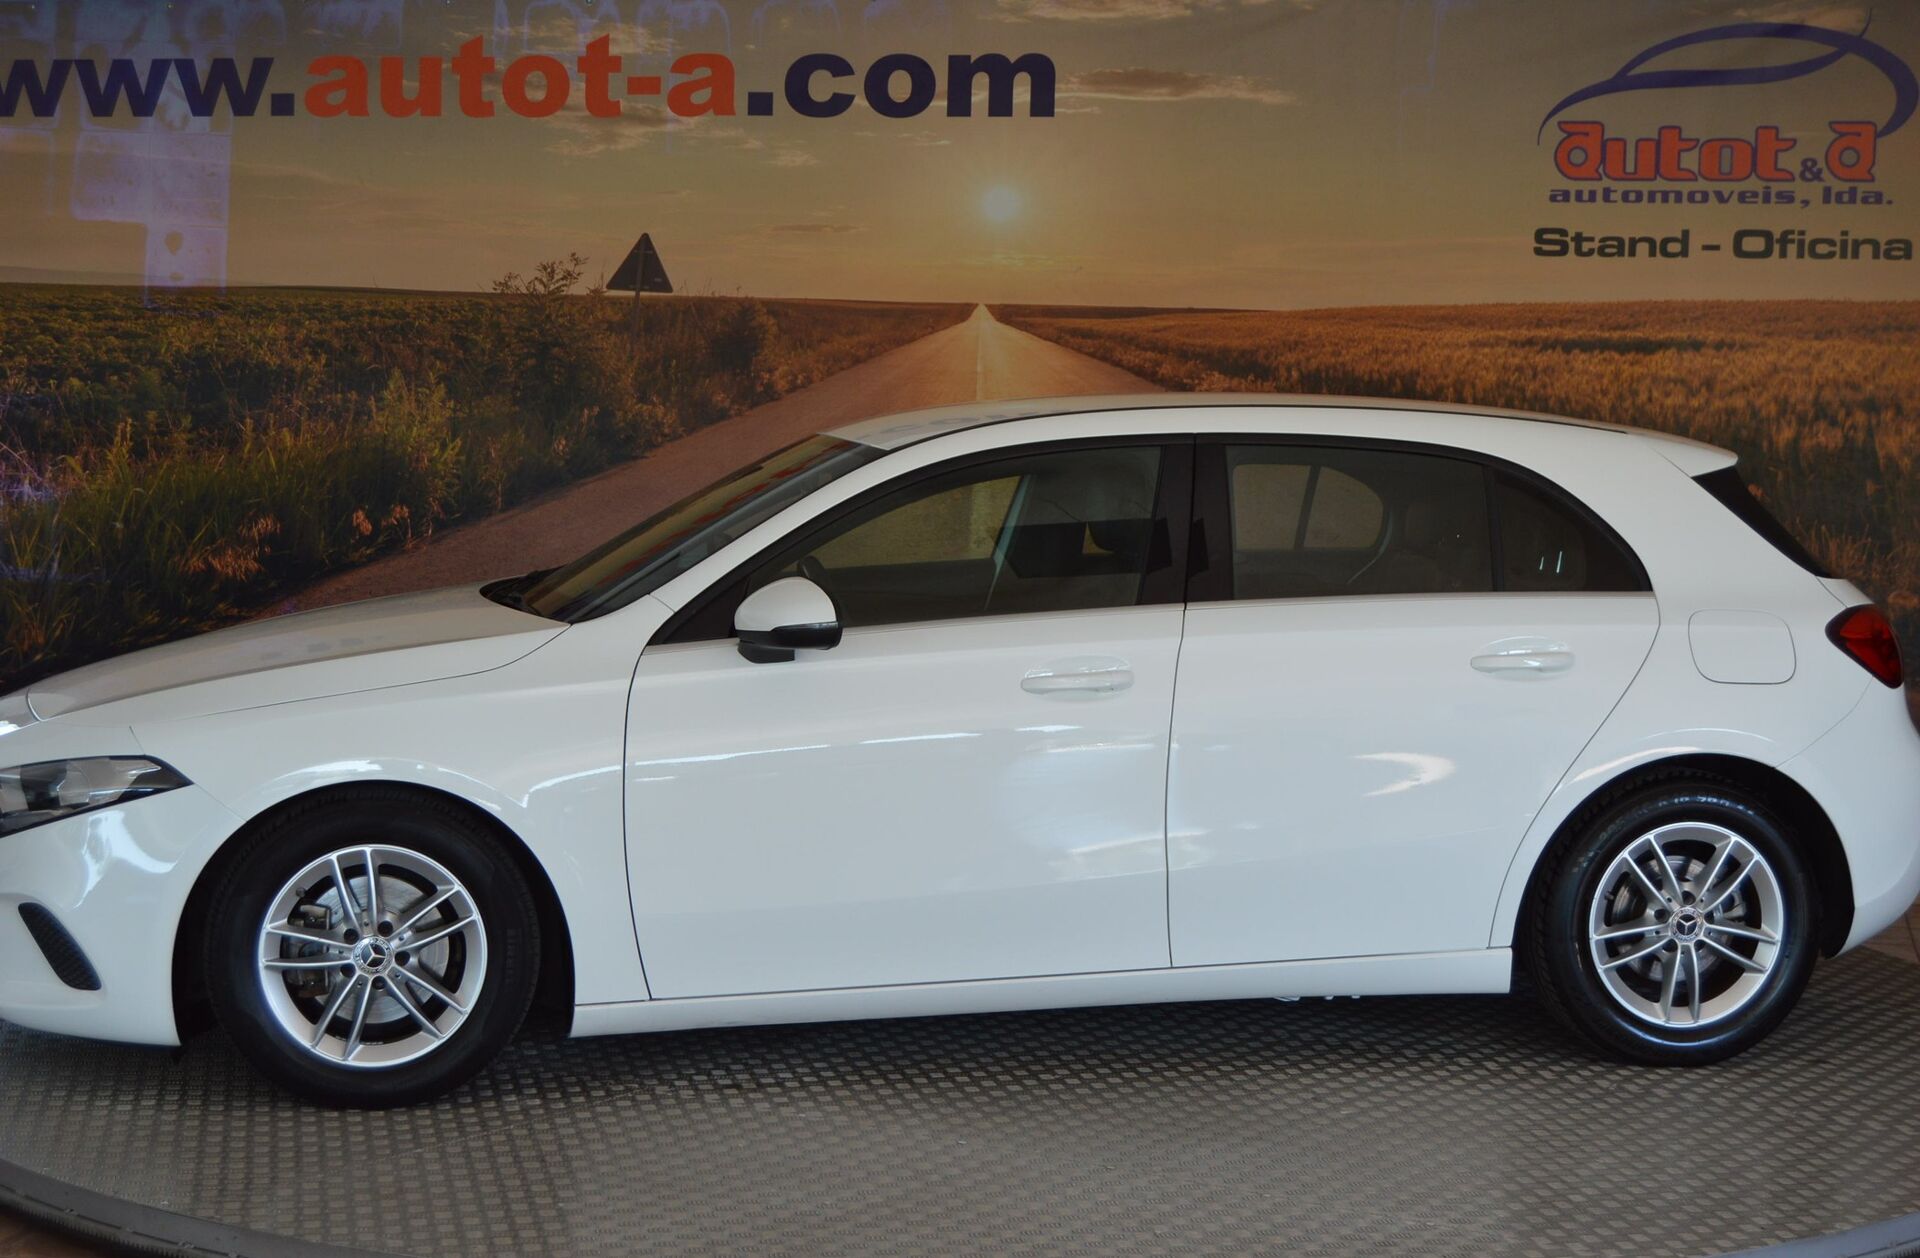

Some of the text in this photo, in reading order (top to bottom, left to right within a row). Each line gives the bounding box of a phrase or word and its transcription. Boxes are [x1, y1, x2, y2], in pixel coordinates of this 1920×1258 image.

[0, 34, 1056, 118] www.autot-a.com
[1549, 185, 1894, 208] automoveis, lda.
[1533, 227, 1690, 258] Stand
[1733, 229, 1913, 260] Oficina
